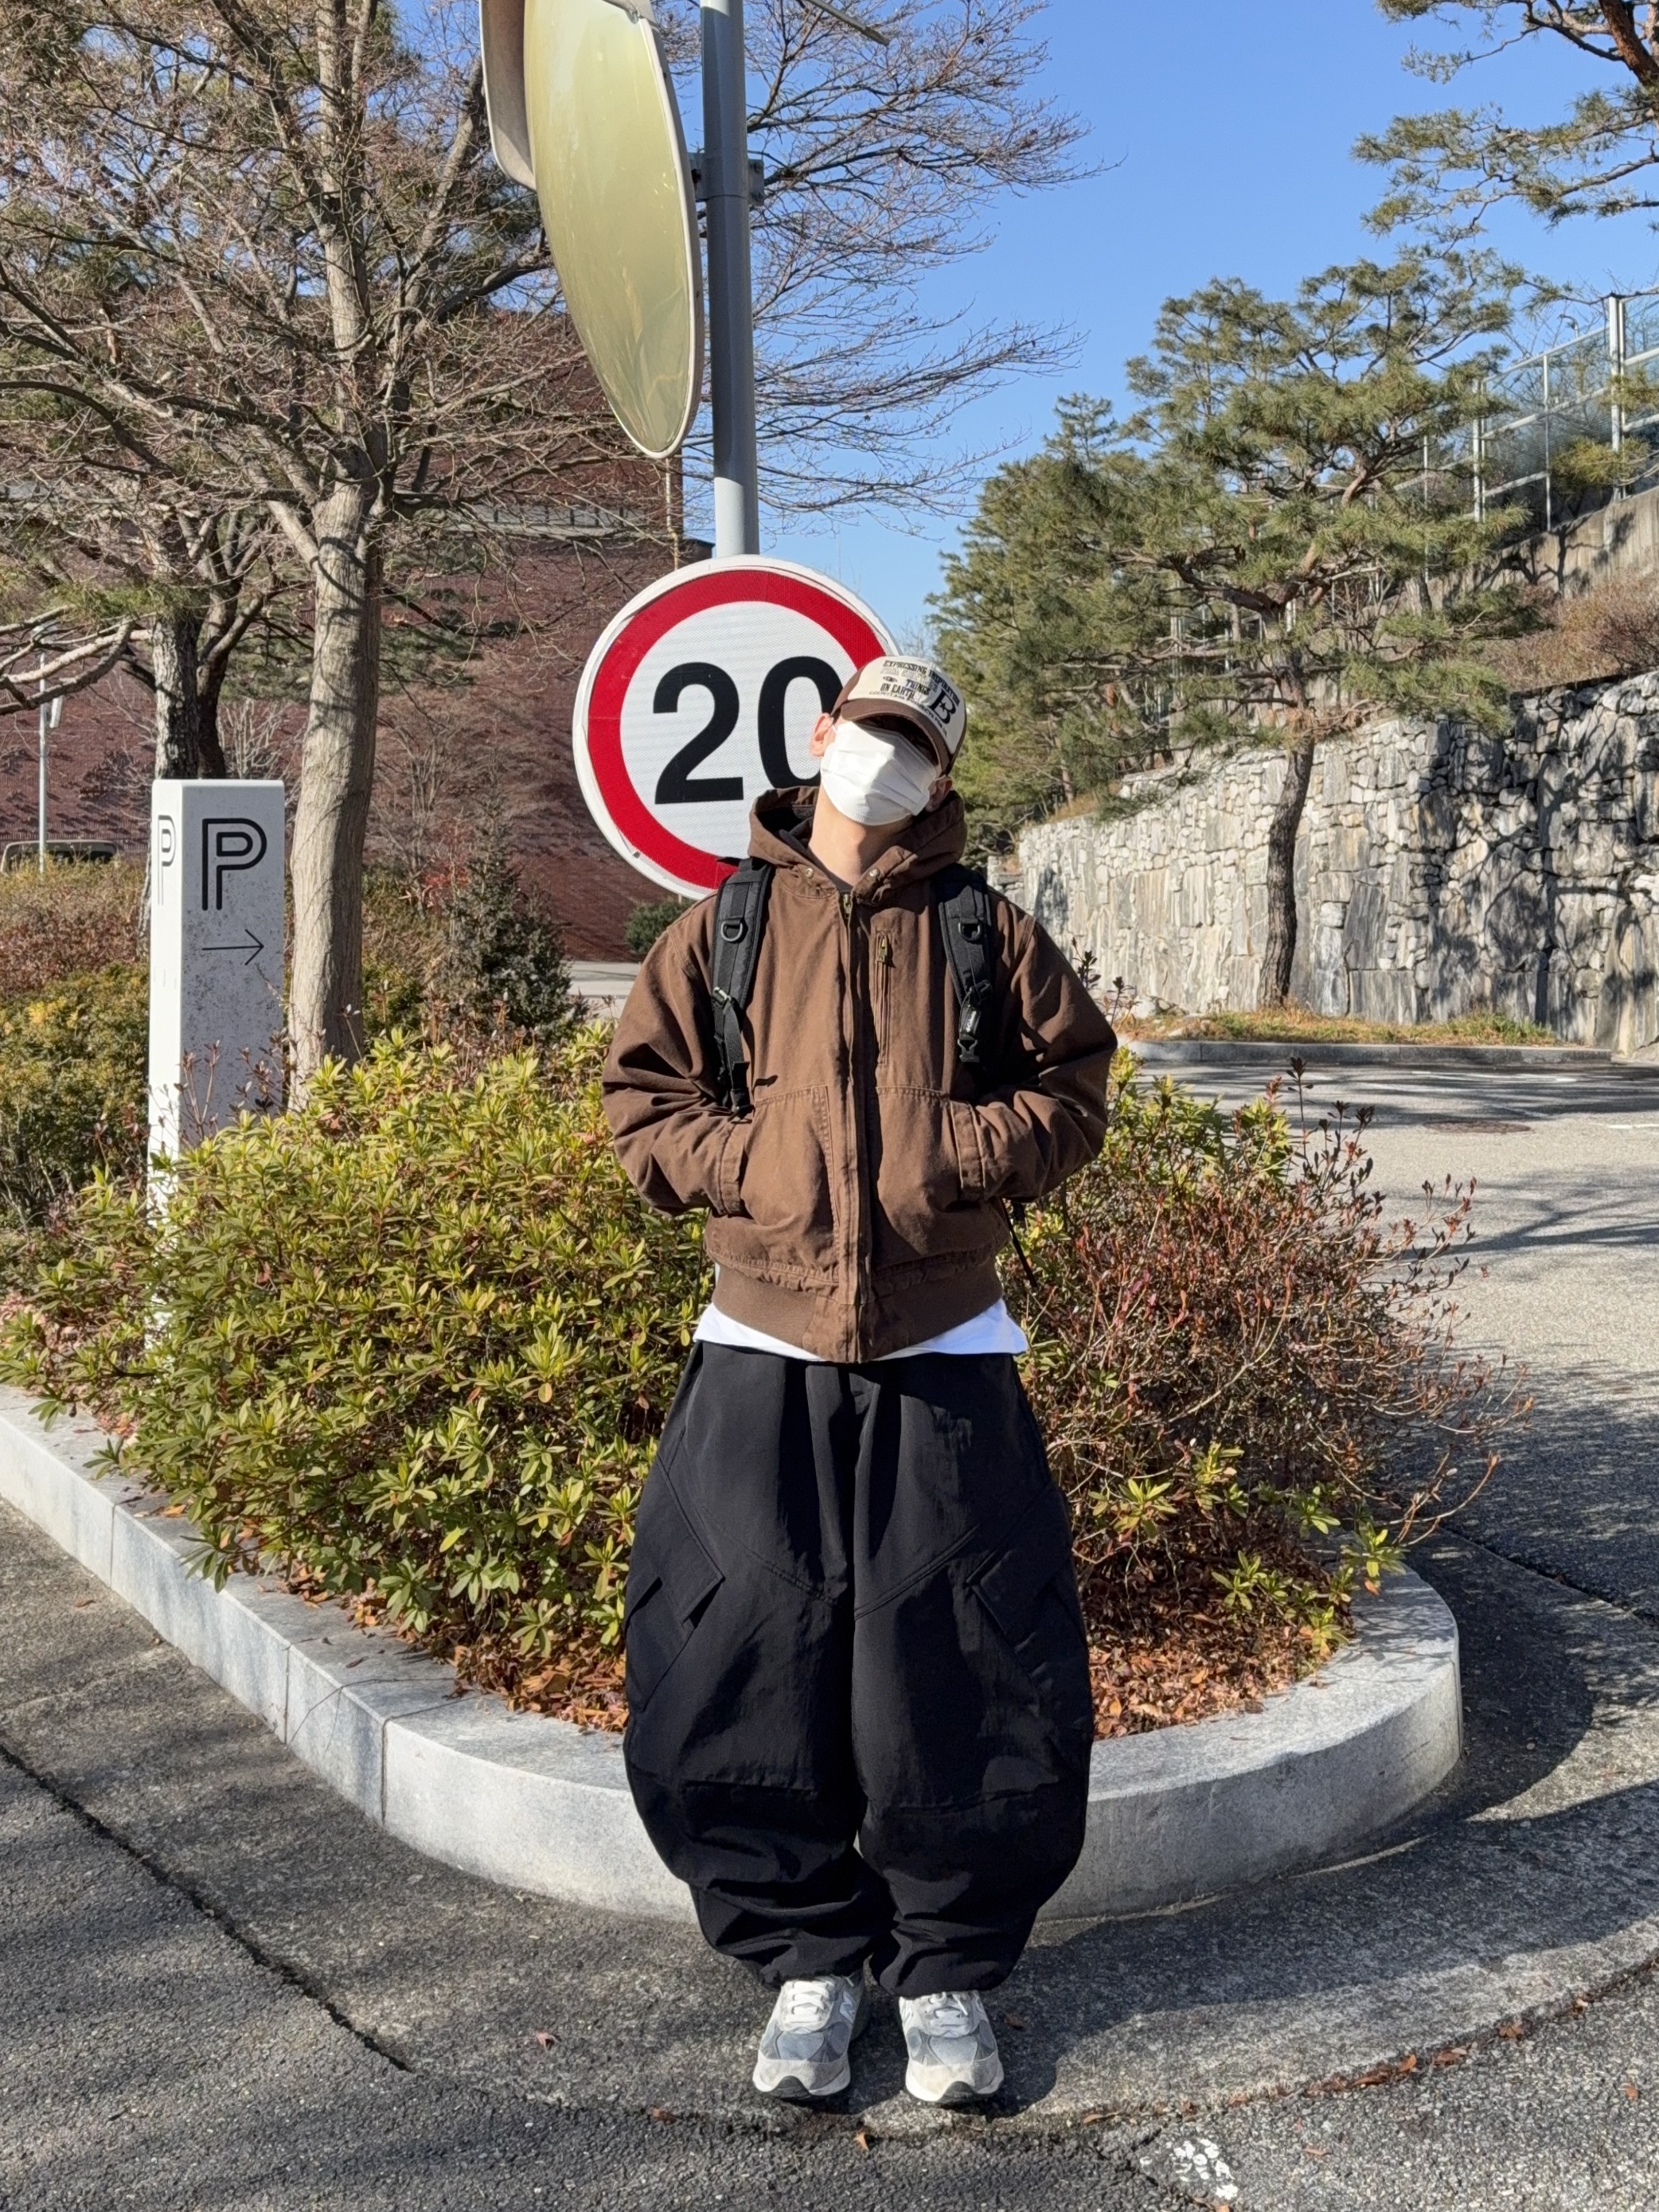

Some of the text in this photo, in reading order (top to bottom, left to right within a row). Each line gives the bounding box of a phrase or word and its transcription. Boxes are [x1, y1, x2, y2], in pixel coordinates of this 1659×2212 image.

[882, 660, 927, 675] EXPRESSING
[880, 682, 915, 699] ON EARTH
[906, 678, 931, 696] THINGS
[928, 688, 956, 724] B
[653, 656, 843, 805] 20
[157, 814, 177, 906] P
[201, 817, 267, 911] P
